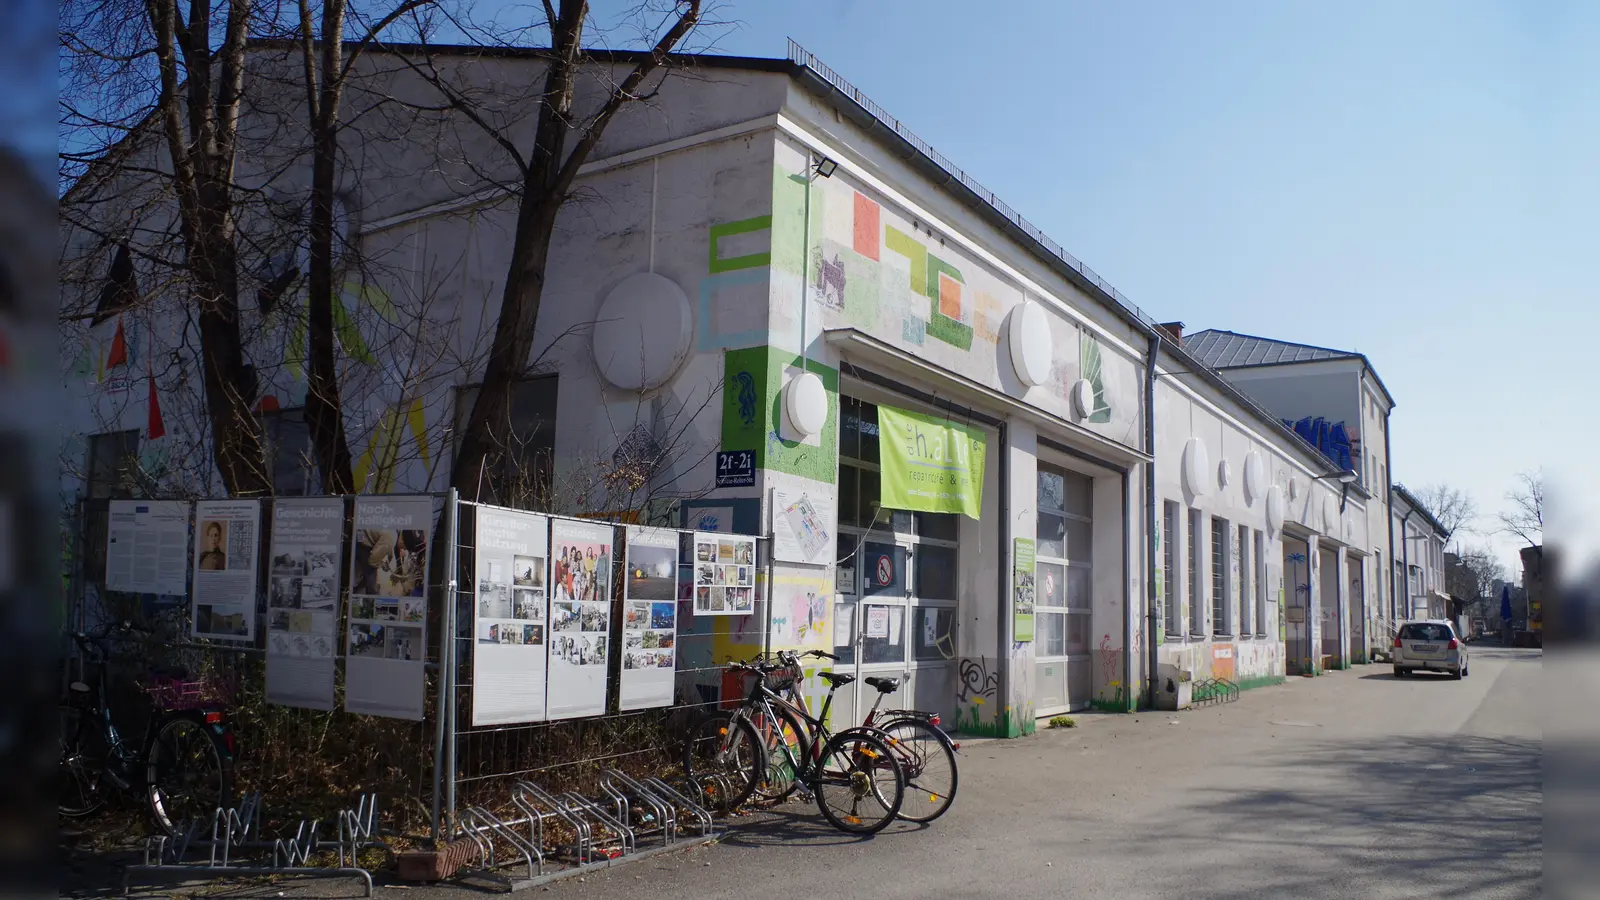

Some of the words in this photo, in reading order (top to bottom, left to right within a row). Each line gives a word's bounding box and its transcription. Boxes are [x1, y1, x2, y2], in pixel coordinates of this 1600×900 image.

[950, 474, 957, 485] &
[276, 507, 340, 519] Geschichte
[480, 535, 528, 554] Nutzung
